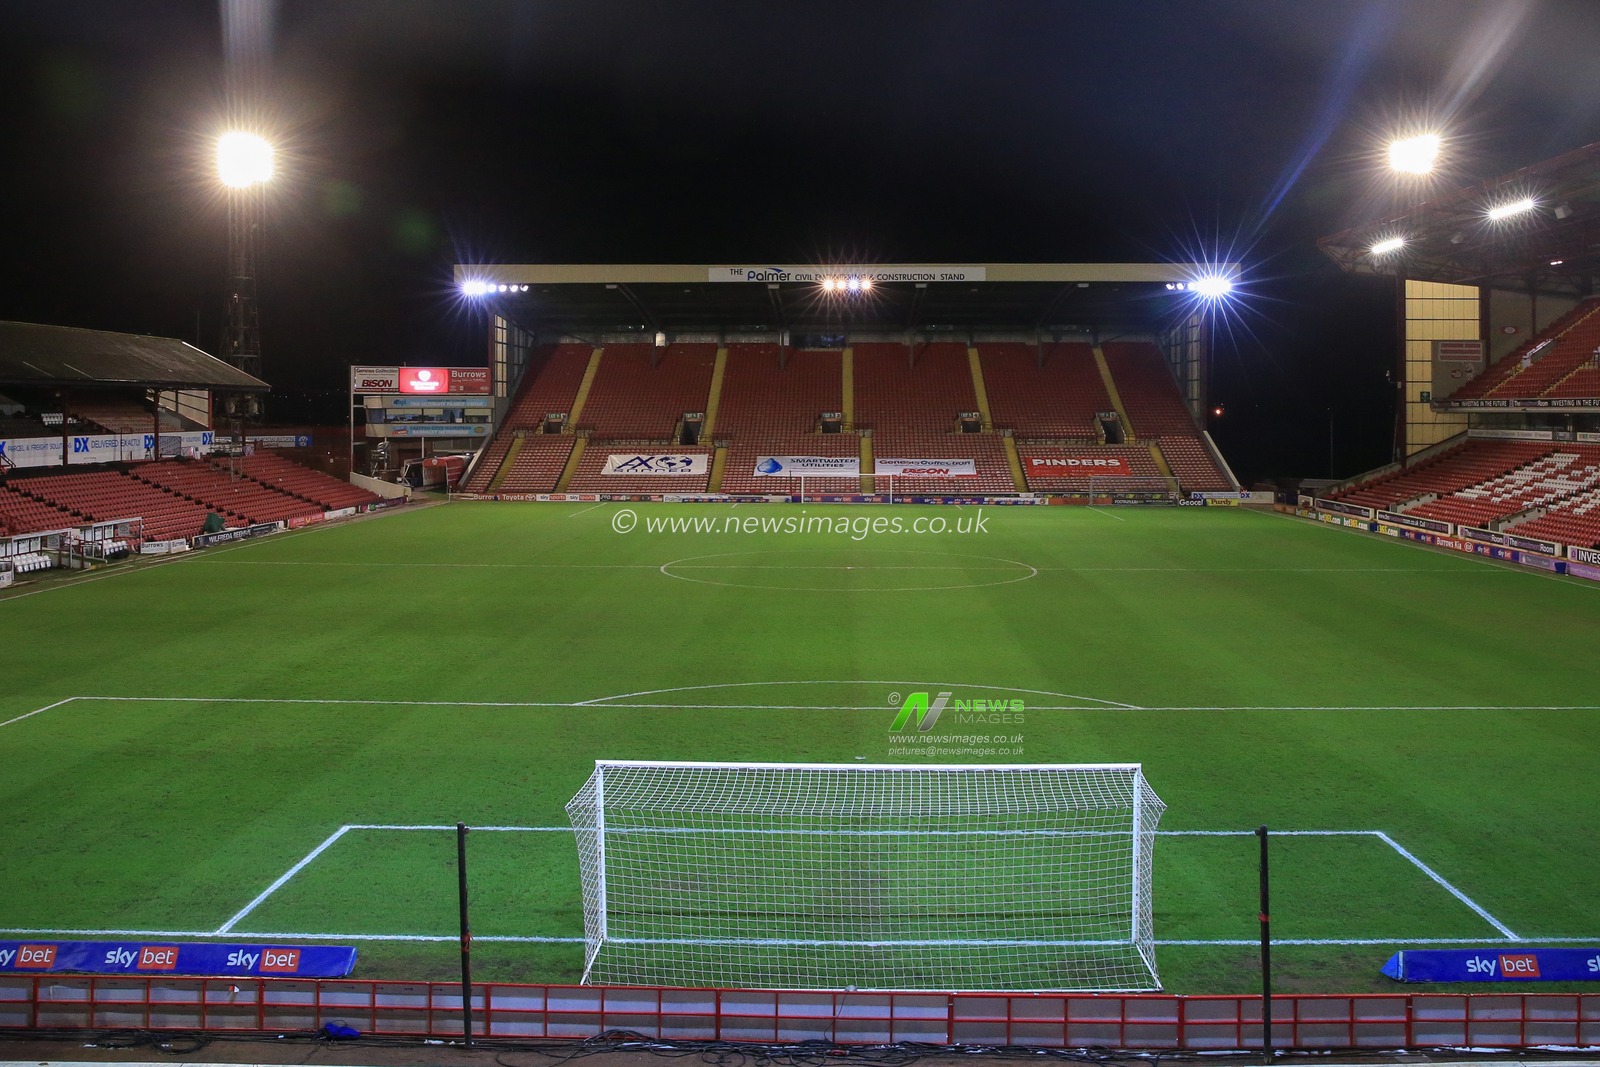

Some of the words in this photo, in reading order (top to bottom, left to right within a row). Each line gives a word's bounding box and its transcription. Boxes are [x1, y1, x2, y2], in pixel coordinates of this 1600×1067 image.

[747, 270, 791, 281] Palmer
[451, 370, 487, 378] Burrows
[74, 437, 89, 452] DX
[91, 440, 118, 449] DELIVERED
[202, 432, 213, 445] DX
[1343, 517, 1368, 531] bet365.com
[208, 533, 233, 543] WILFREDA
[1437, 537, 1453, 548] Burrows
[1491, 534, 1503, 543] Room
[1509, 537, 1517, 546] The
[1540, 543, 1554, 554] Room
[20, 946, 53, 963] bet
[105, 947, 138, 968] sky
[142, 948, 174, 965] bet
[227, 949, 260, 970] sky
[264, 951, 296, 967] bet
[1465, 955, 1496, 976] sky
[1502, 957, 1535, 973] bet
